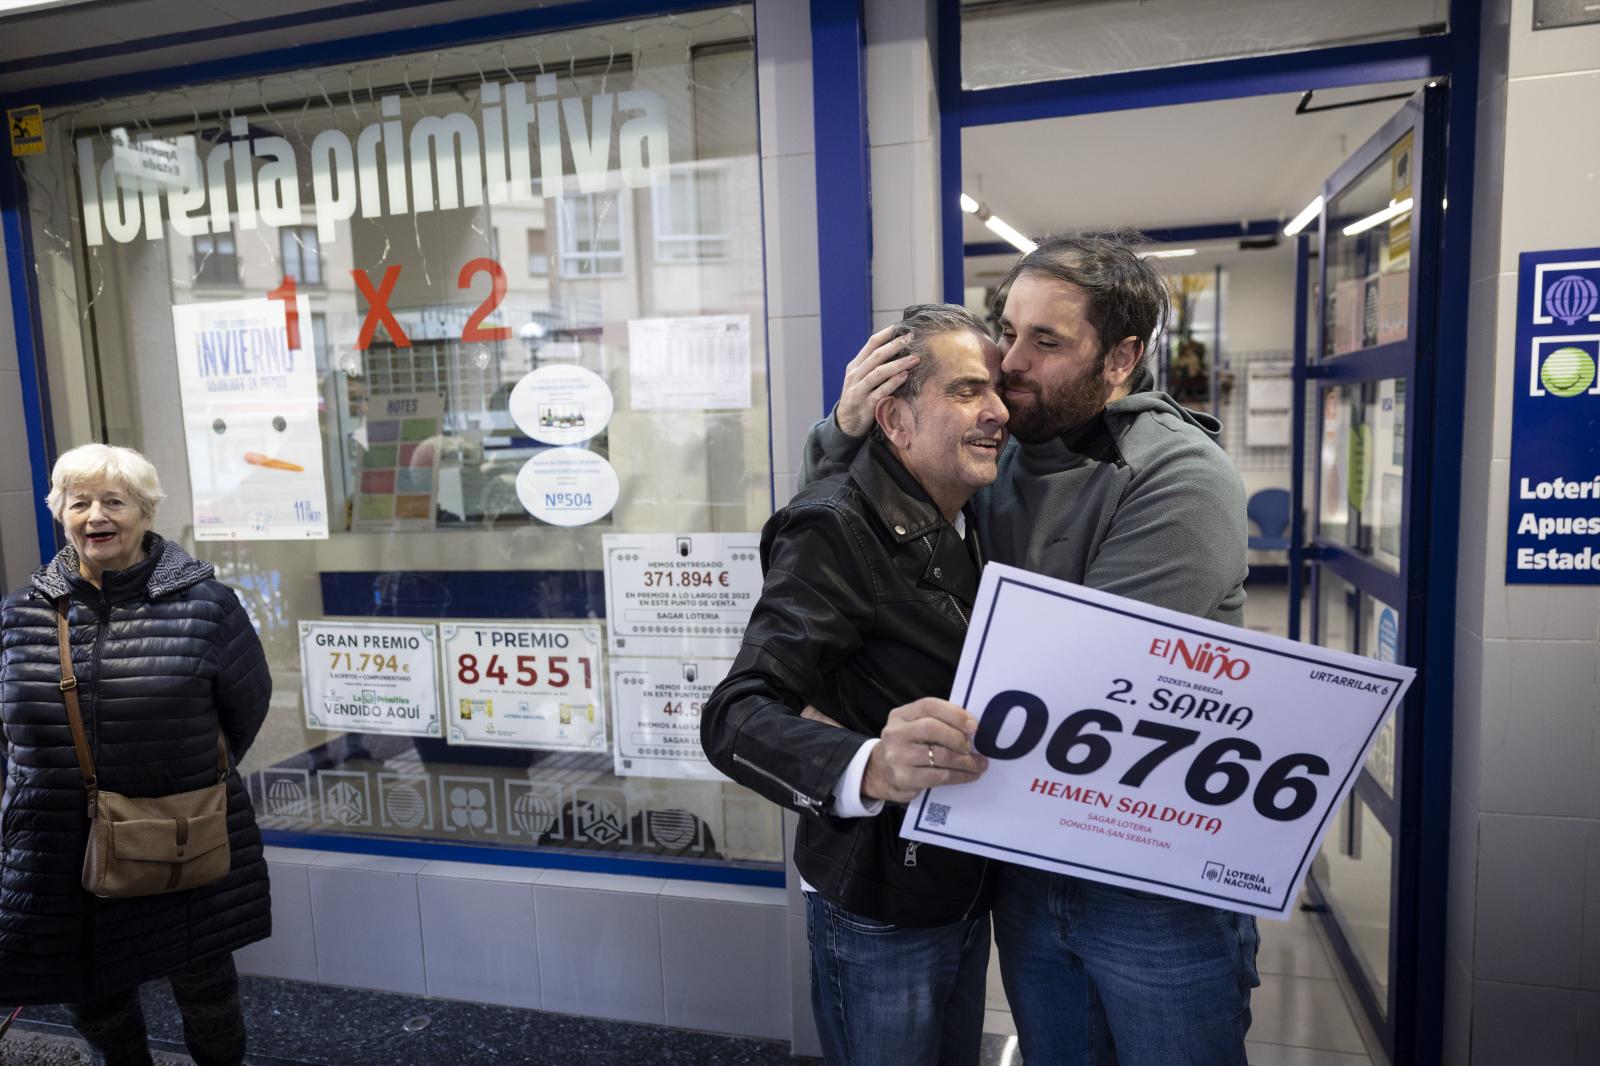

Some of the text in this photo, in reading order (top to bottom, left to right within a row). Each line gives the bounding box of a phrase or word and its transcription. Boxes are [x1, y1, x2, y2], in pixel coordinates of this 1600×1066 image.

[76, 73, 671, 246] loteria primitiva
[267, 257, 512, 350] 1 X 2
[545, 493, 592, 507] Nº504
[1517, 512, 1600, 541] Apues
[644, 571, 730, 587] 371.894 €
[316, 634, 420, 650] GRAN PREMIO
[491, 632, 569, 649] PREMIO
[330, 652, 409, 673] 71.794 €
[1169, 638, 1250, 681] Niño
[362, 674, 412, 682] COMPLEMENTARIO
[458, 653, 592, 689] 84551
[1156, 675, 1224, 696] ZOZKETA BEREZIA
[1310, 669, 1389, 696] URTARRILAK 6
[324, 703, 420, 719] VENDIDO AQUÍ
[663, 701, 706, 717] 44.5
[1106, 678, 1254, 731] 2. SARIA
[973, 689, 1330, 822] 06766
[1030, 778, 1222, 836] HEMEN SALDUTA
[1087, 813, 1152, 833] SAGAR LOTERIA
[1059, 818, 1172, 850] DONOSTIA-SAN SEBASTIAN
[1223, 877, 1272, 895] NACIONAL
[1226, 869, 1265, 884] LOTERÍA
